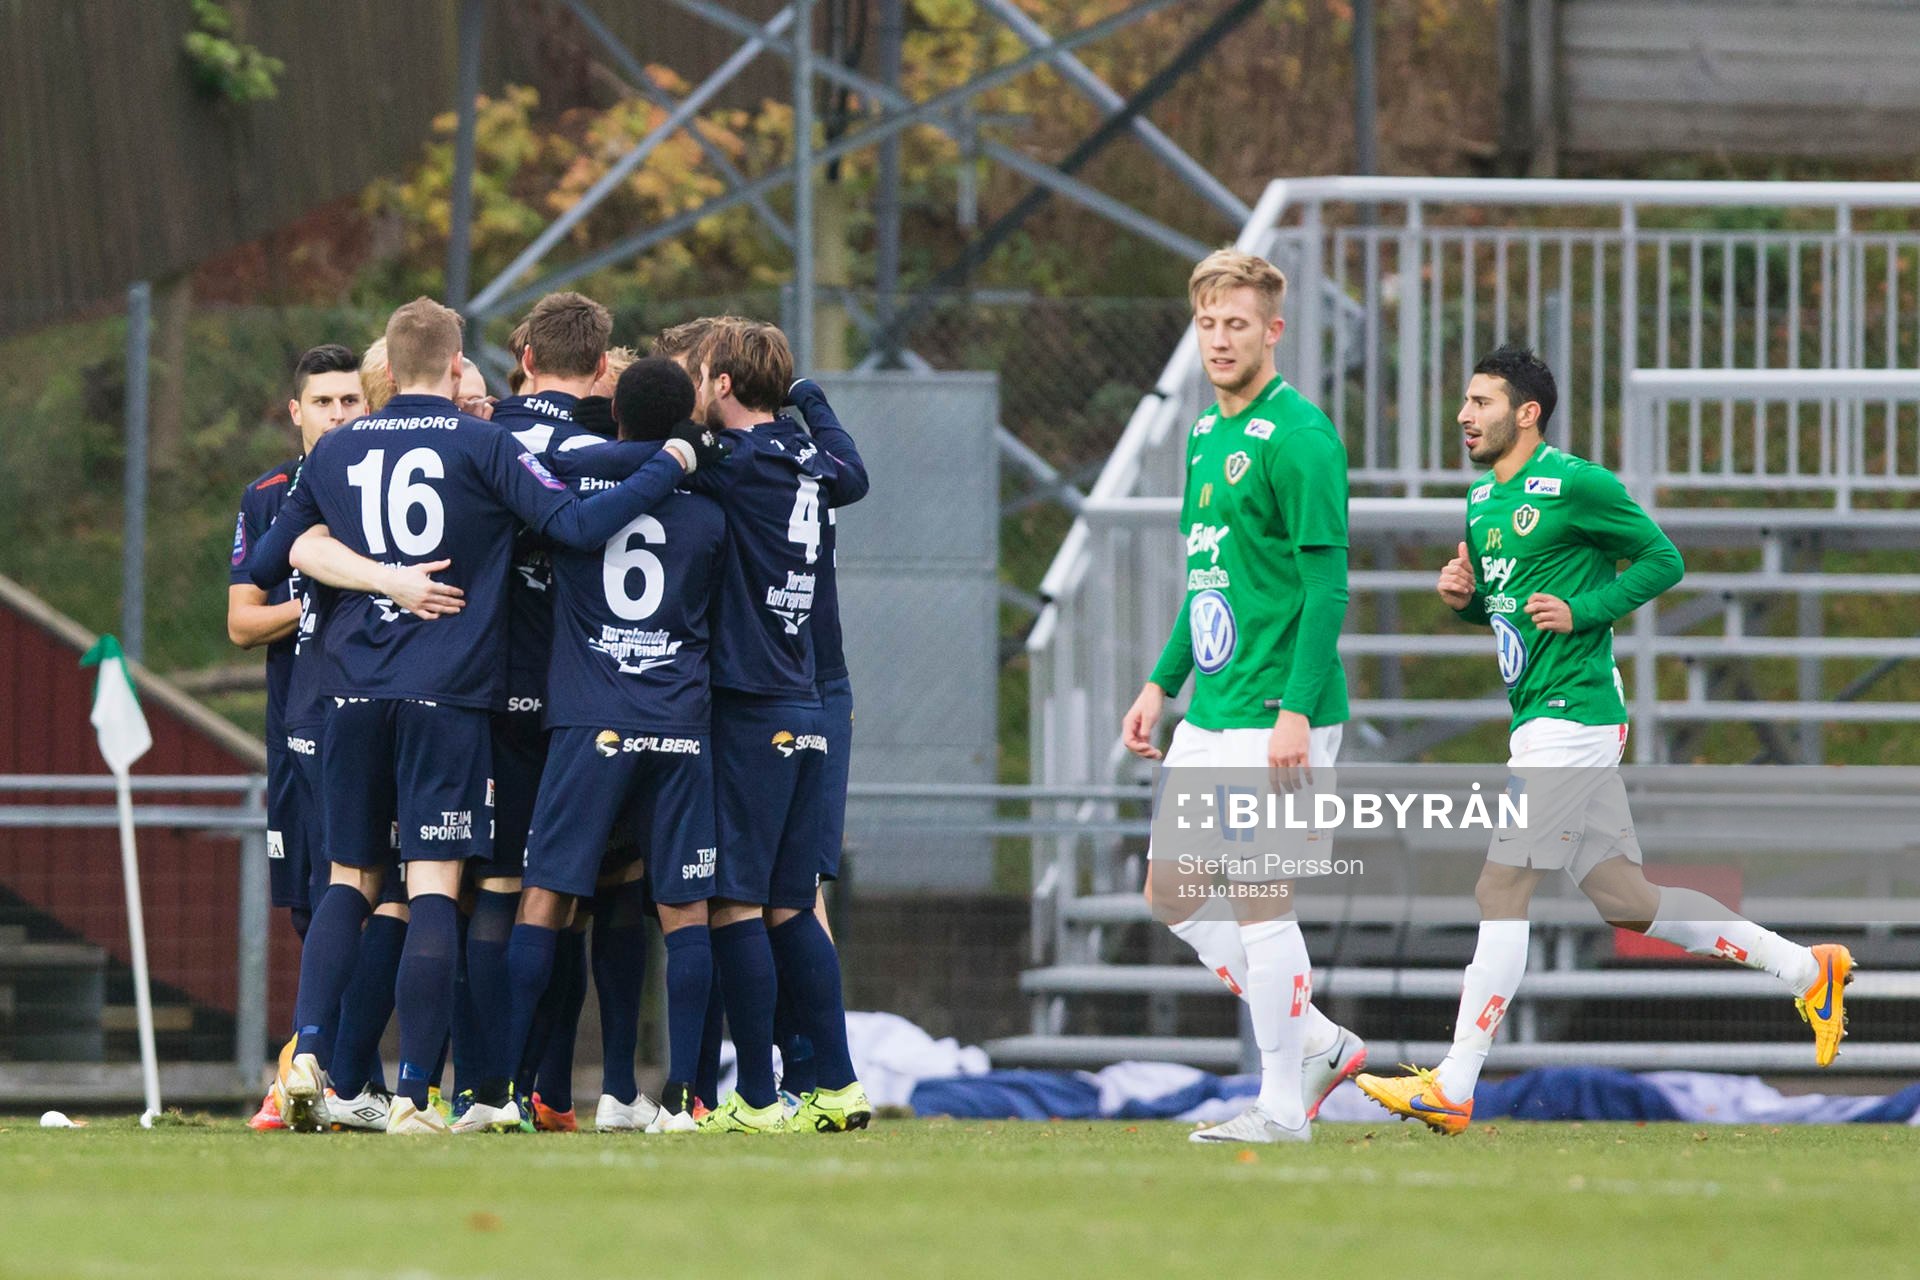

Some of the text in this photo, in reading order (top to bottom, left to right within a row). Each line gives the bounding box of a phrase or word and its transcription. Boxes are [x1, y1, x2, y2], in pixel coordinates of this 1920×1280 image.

[352, 416, 459, 430] EHRENBORG
[347, 447, 445, 556] 16
[788, 473, 822, 564] 4
[603, 513, 666, 621] 6
[420, 825, 472, 840] SPORTIA
[441, 811, 471, 825] TEAM
